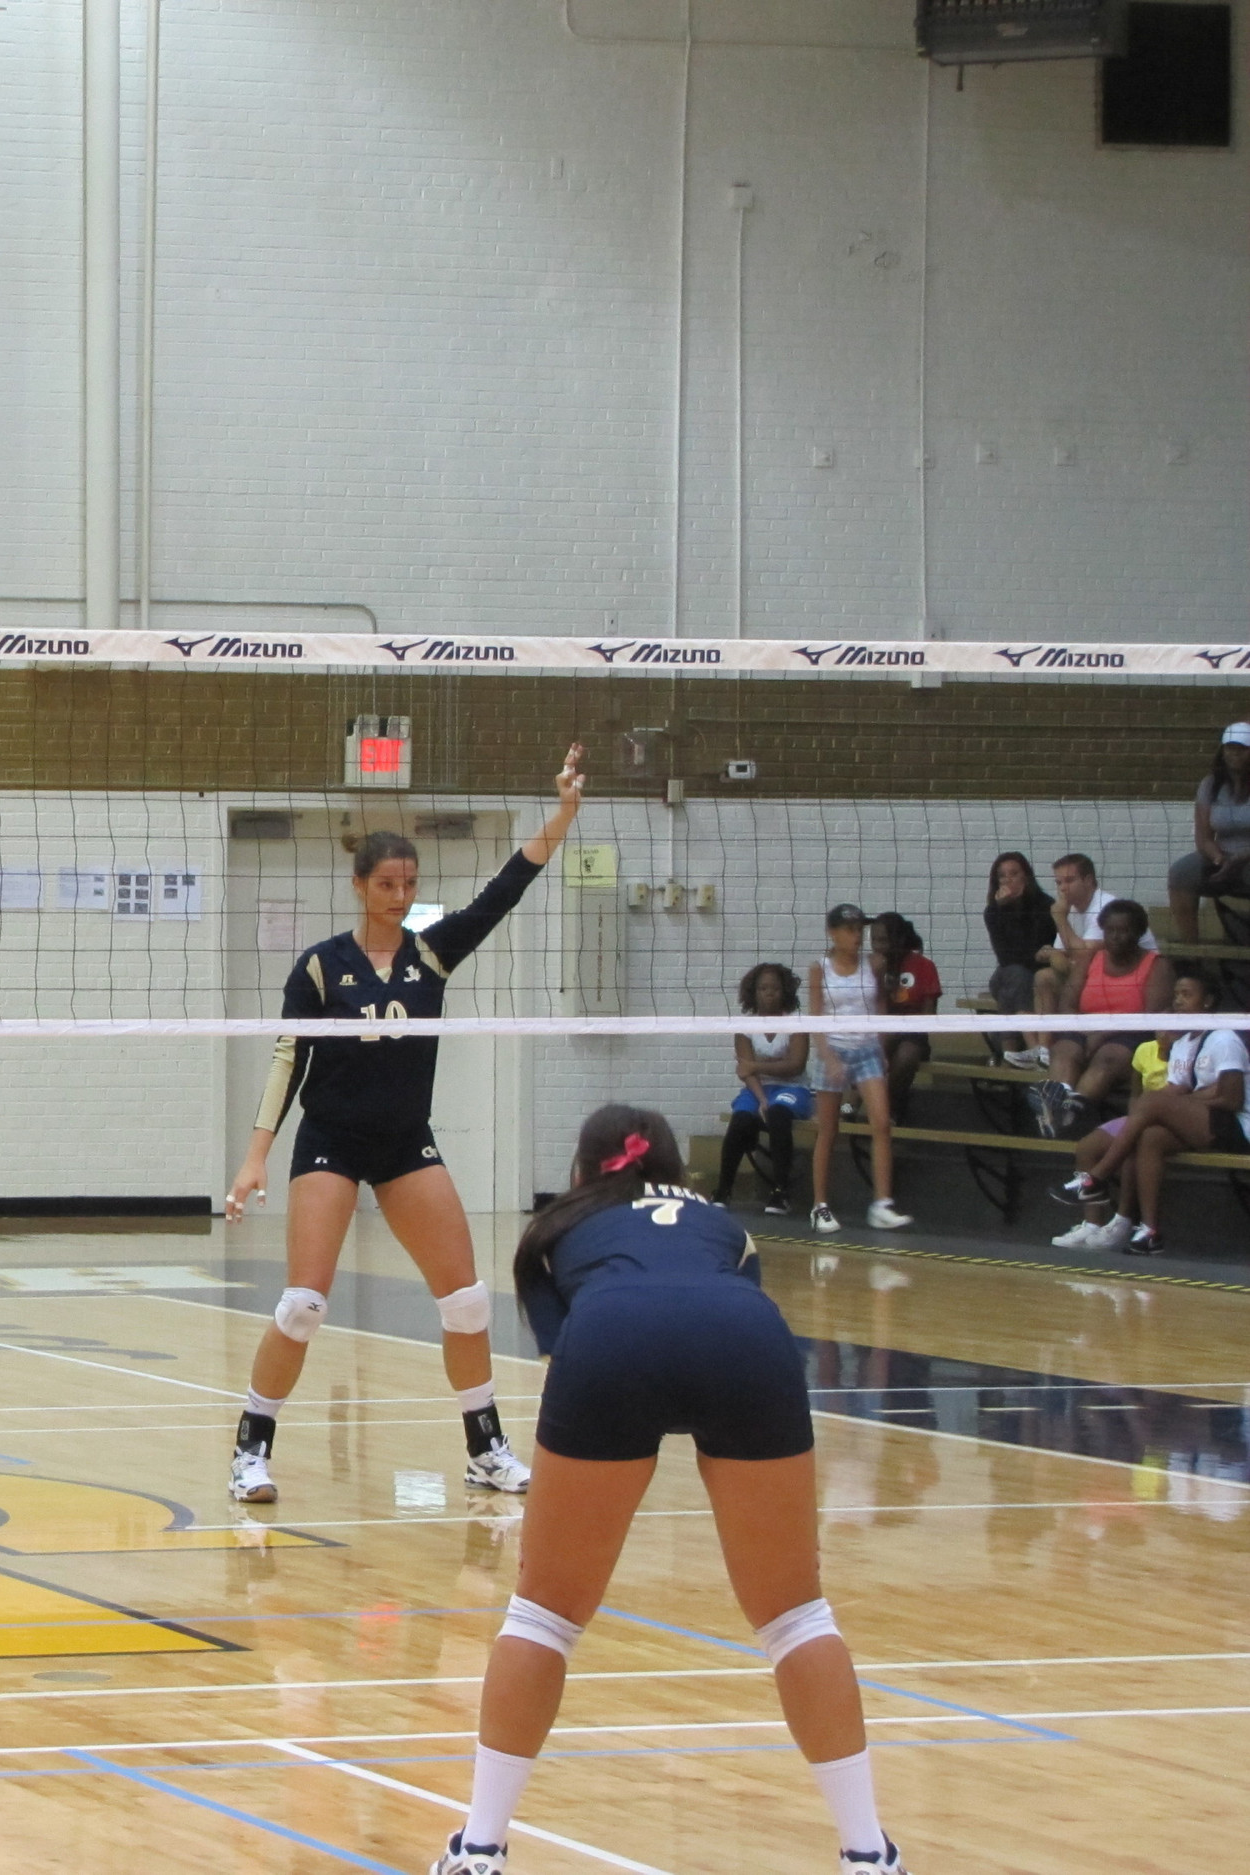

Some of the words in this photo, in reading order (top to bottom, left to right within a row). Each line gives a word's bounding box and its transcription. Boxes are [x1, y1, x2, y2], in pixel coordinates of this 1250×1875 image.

[206, 636, 303, 658] MIZUNO
[420, 639, 515, 661] MIZUNO
[628, 641, 721, 664] MIZUNO
[834, 645, 925, 666] MIZUNO
[1035, 646, 1125, 668] MIZUNO
[361, 738, 404, 772] EXIT
[632, 1197, 684, 1225] 7
